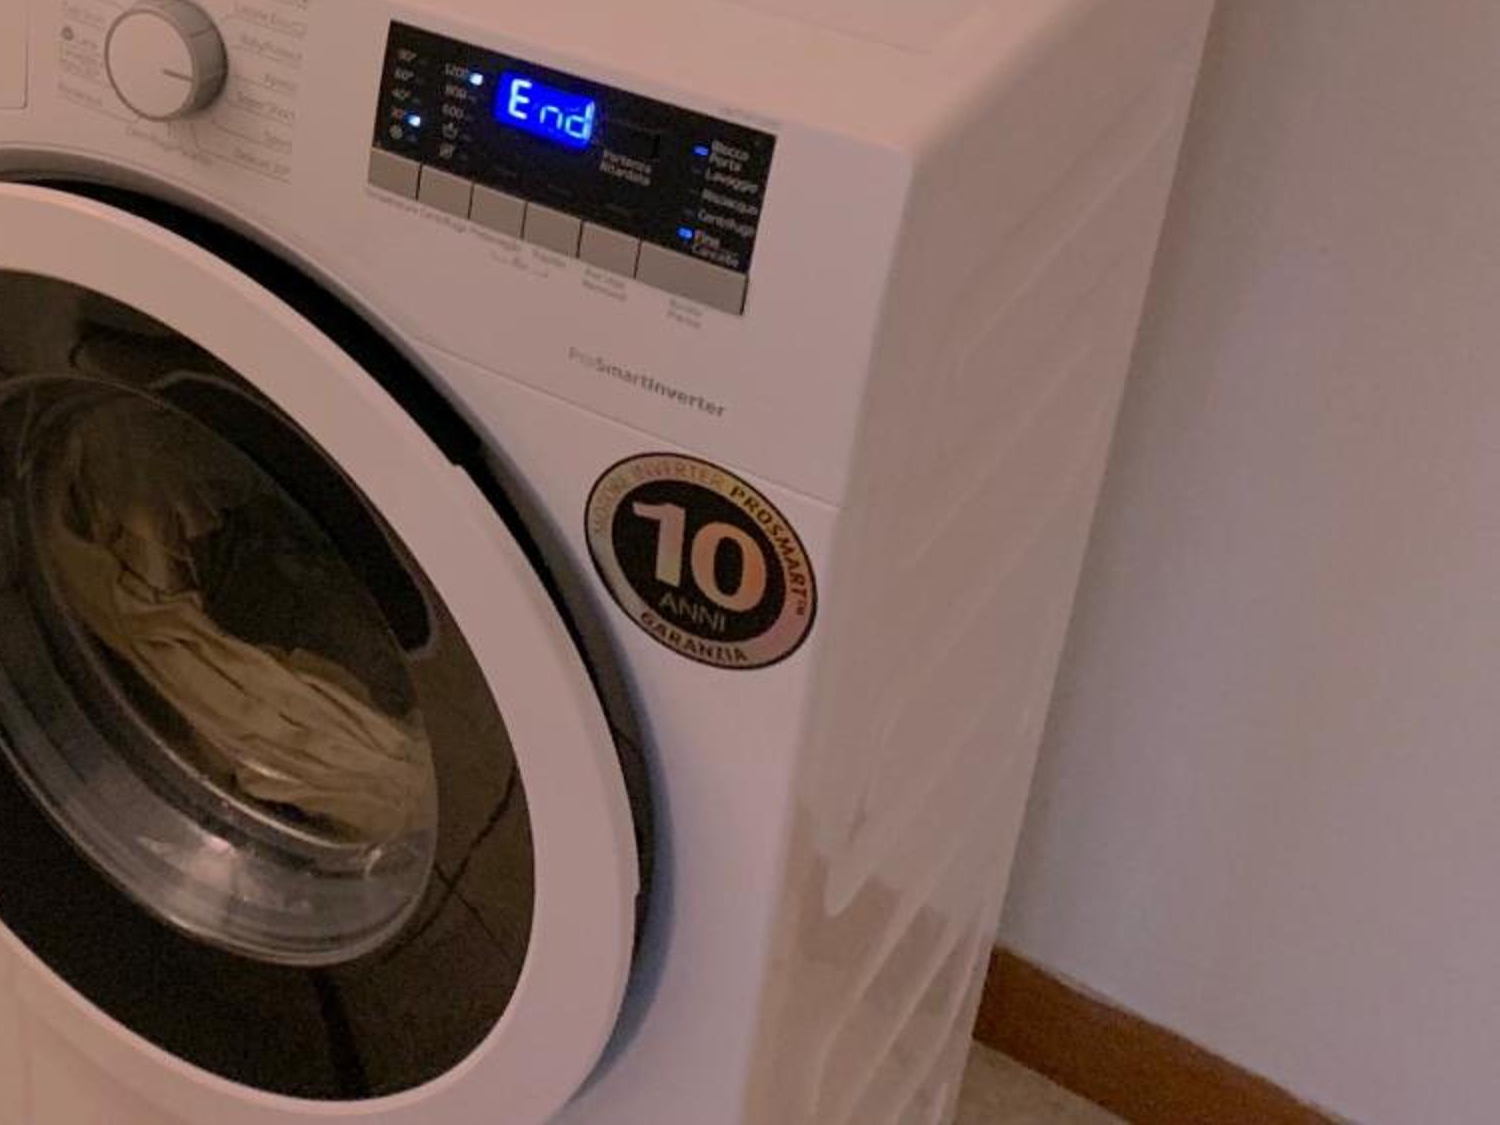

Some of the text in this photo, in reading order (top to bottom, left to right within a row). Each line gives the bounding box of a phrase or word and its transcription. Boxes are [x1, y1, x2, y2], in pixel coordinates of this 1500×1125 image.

[508, 78, 596, 141] End
[567, 346, 727, 417] ProSmartInverter
[631, 500, 769, 613] 10
[639, 611, 750, 664] GARANZIA
[659, 590, 726, 633] ANNI
